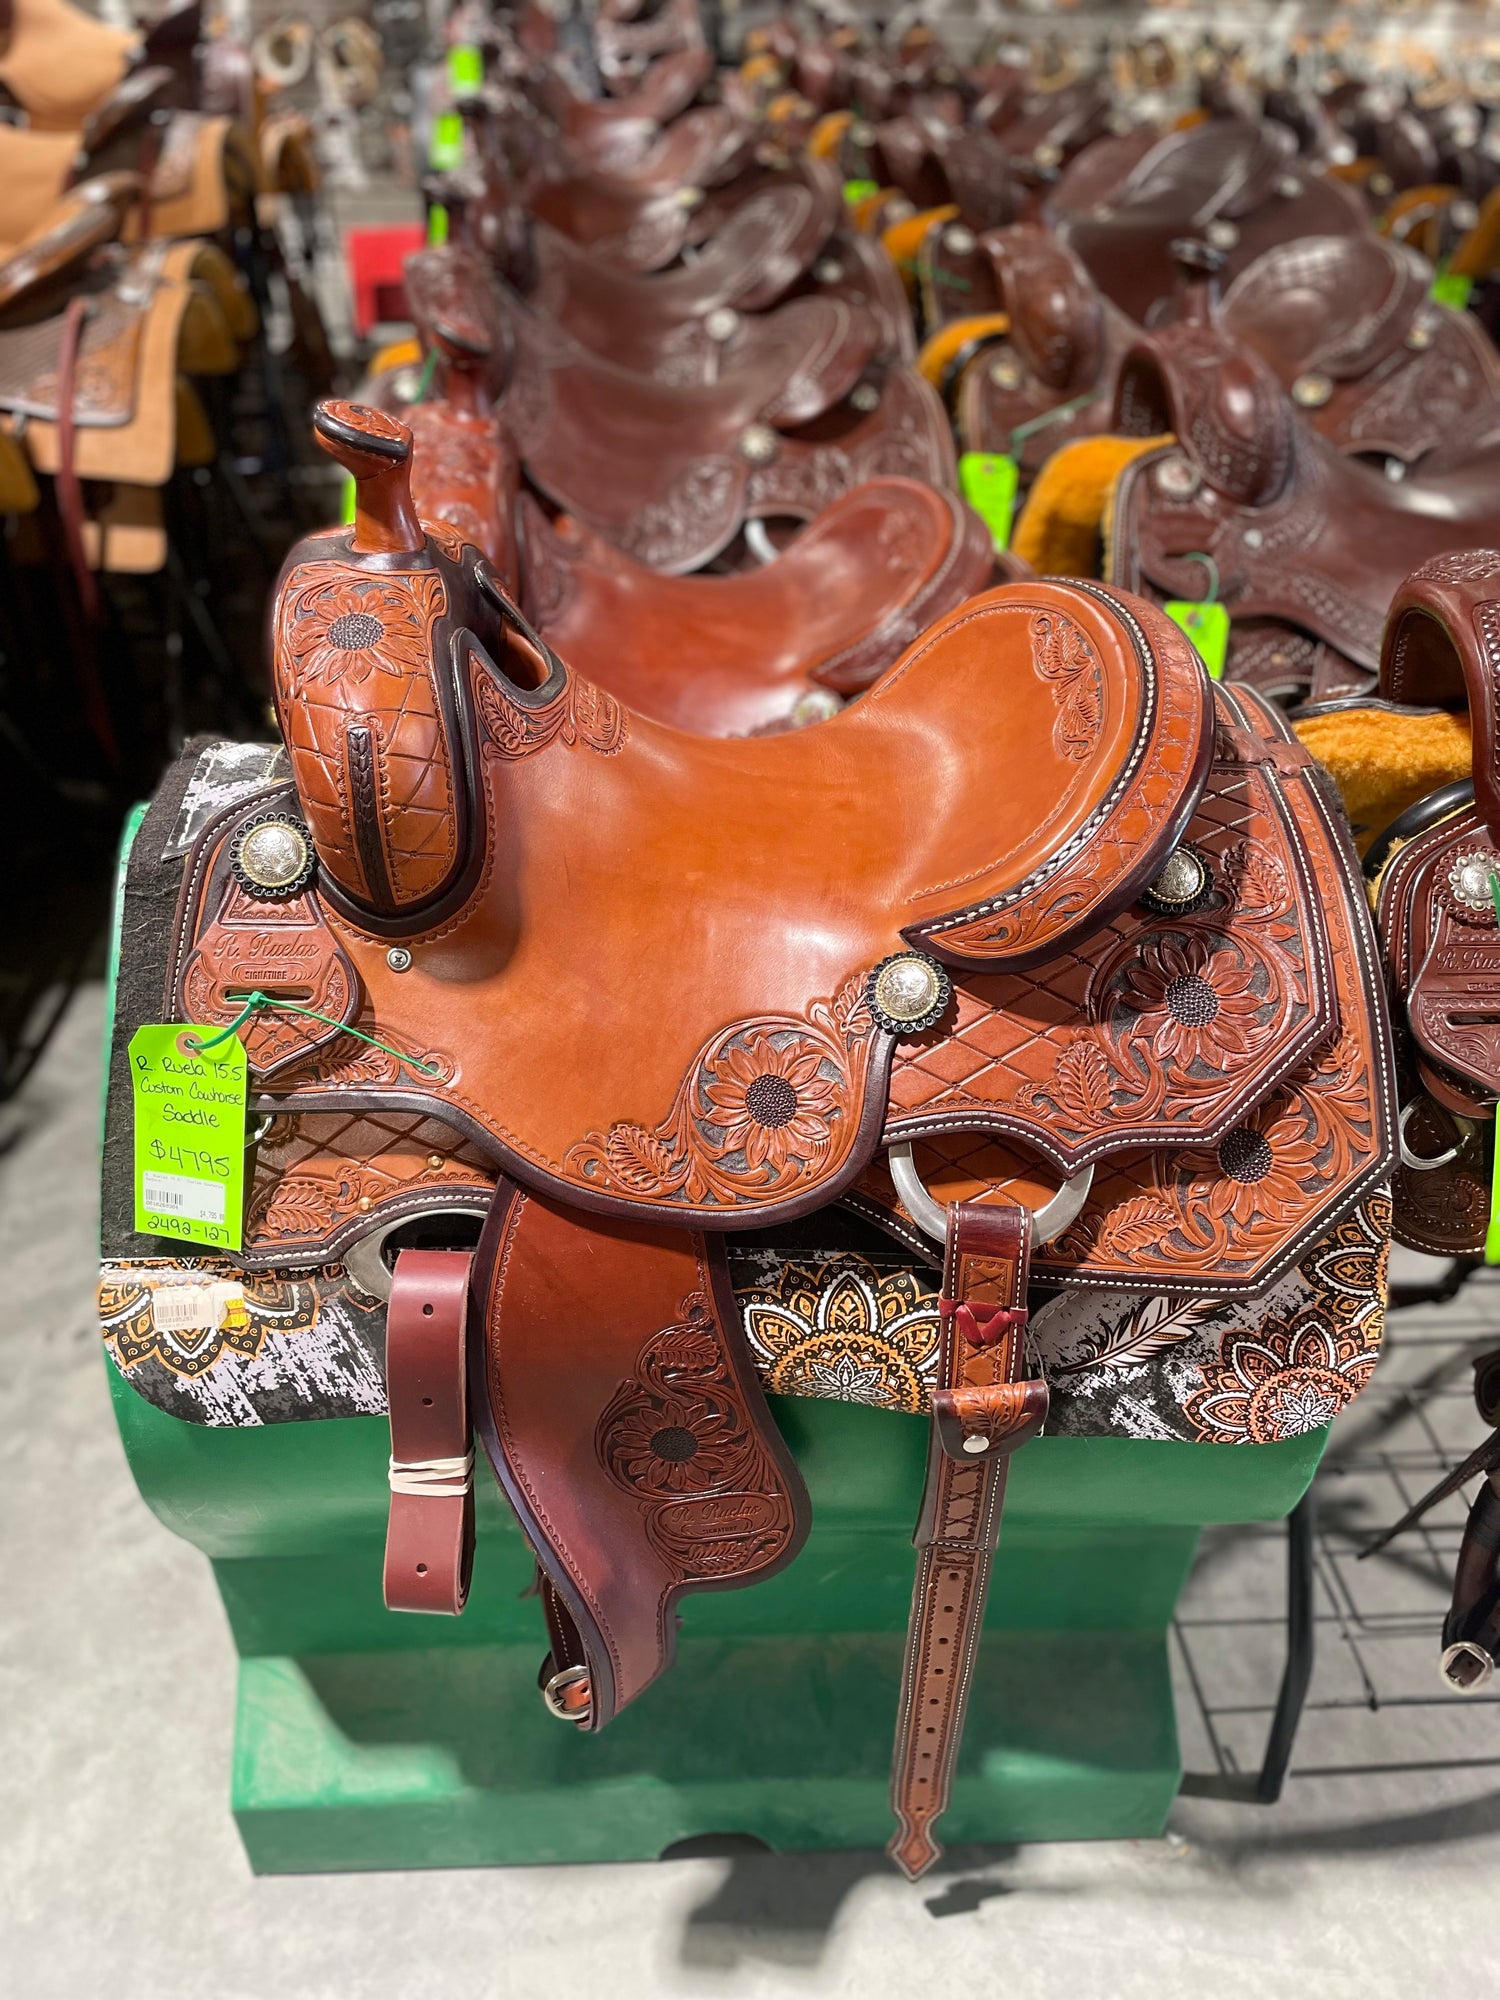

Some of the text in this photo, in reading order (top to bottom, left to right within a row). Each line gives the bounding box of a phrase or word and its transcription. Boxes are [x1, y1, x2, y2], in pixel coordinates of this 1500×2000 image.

[213, 931, 320, 959] R. Ruelas
[244, 970, 287, 980] SIGNATURE
[140, 1076, 184, 1096] Custom
[162, 1103, 220, 1128] Saddle
[149, 1139, 230, 1177] $4795
[147, 1215, 230, 1244] 2492-127
[701, 1499, 762, 1520] Ruelas
